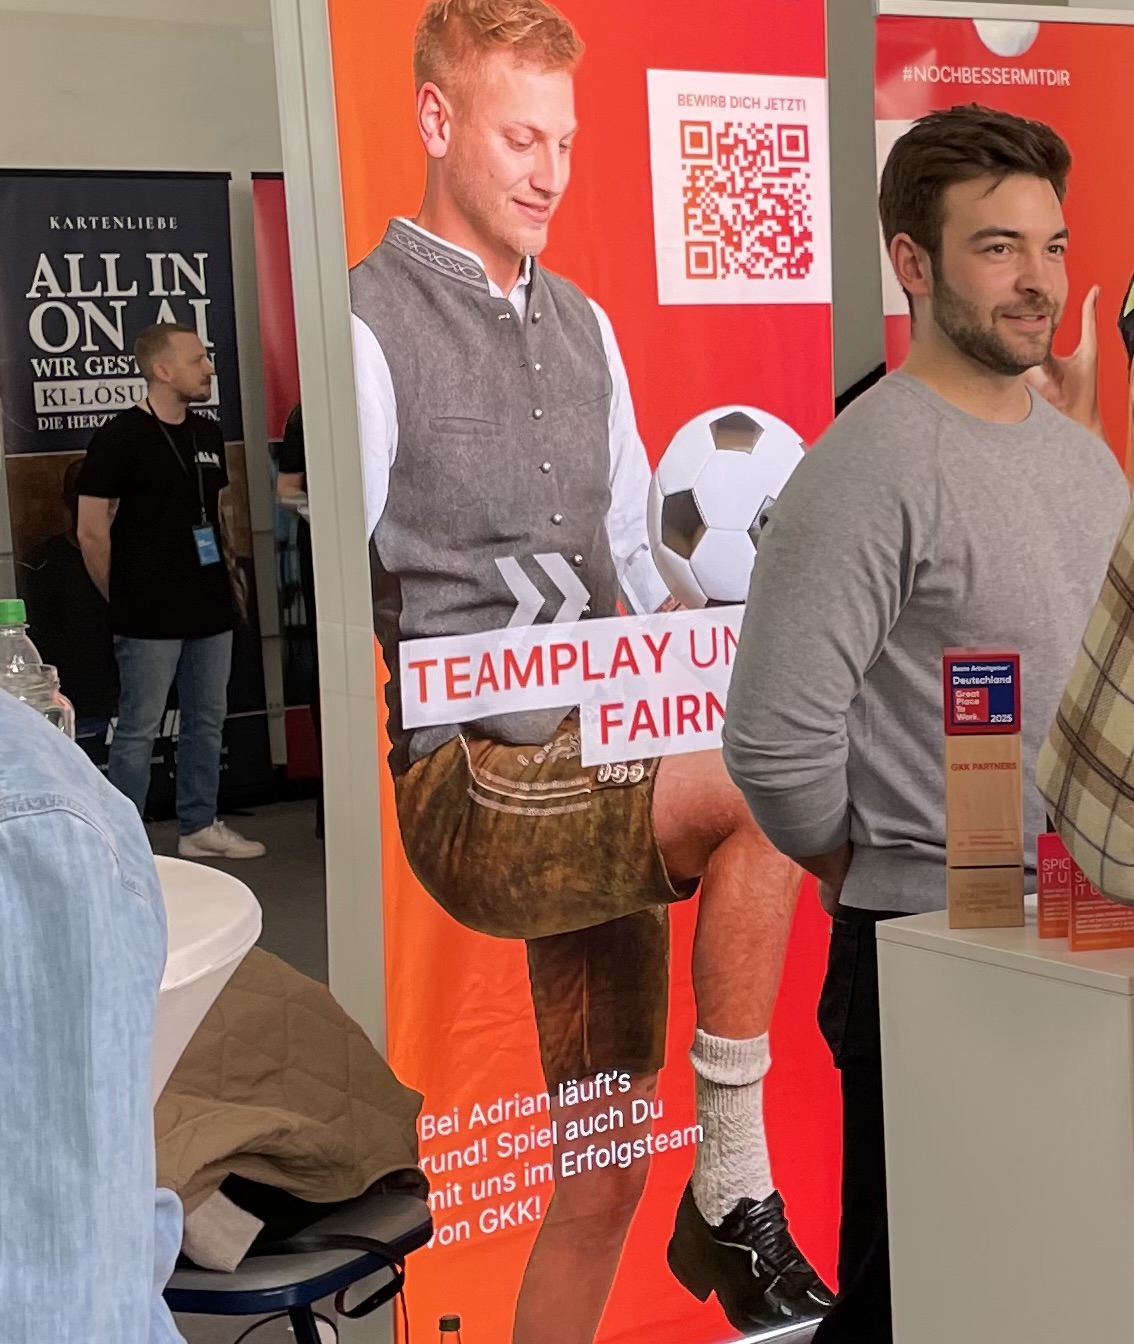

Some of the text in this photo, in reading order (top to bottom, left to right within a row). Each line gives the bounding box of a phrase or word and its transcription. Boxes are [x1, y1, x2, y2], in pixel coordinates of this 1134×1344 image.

[902, 66, 1071, 86] #NOCHBESSERMITDIR
[677, 93, 807, 113] BEWIRB DICH JETZT!
[50, 216, 178, 230] KARTENLIEBE
[26, 252, 208, 299] ALL IN
[28, 300, 127, 353] ON
[31, 358, 79, 377] WIR
[42, 382, 147, 407] KI-LÖSU
[38, 416, 63, 431] DIE
[408, 632, 672, 703] TEAMPLAY
[953, 675, 1012, 685] Deutschland
[972, 762, 1017, 771] PARTNERS
[421, 1108, 460, 1141] Bei
[468, 1092, 550, 1130] Adrian
[420, 1098, 664, 1175] rund! Spiel auch Du
[471, 1172, 516, 1201] uns
[524, 1161, 553, 1189] im
[561, 1124, 704, 1178] Erfolgsteam
[479, 1196, 542, 1235] GKK!
